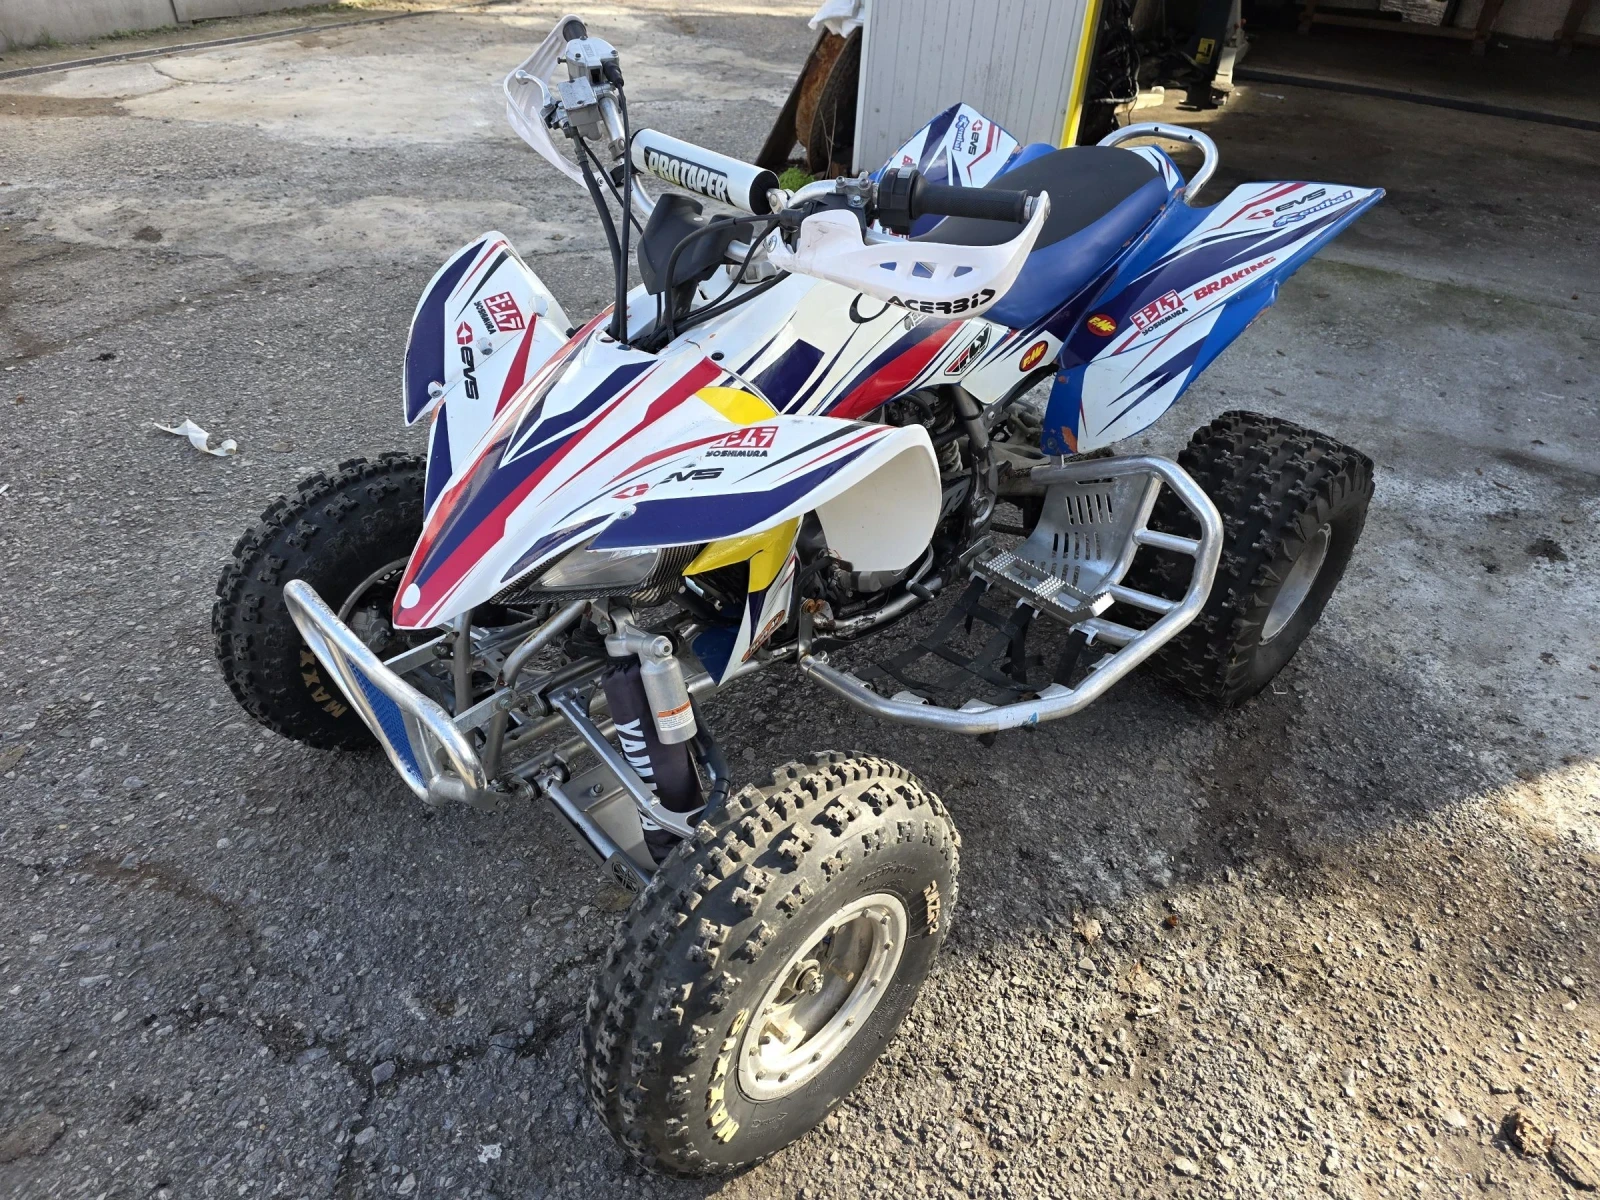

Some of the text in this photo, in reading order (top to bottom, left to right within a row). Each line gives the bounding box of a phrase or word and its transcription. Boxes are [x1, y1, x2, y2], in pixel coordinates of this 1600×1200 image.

[648, 150, 729, 203] PROTAPER
[1193, 256, 1276, 301] BRAKING
[473, 301, 497, 335] YOSHIMURA
[1142, 307, 1188, 336] YOSHIMURA
